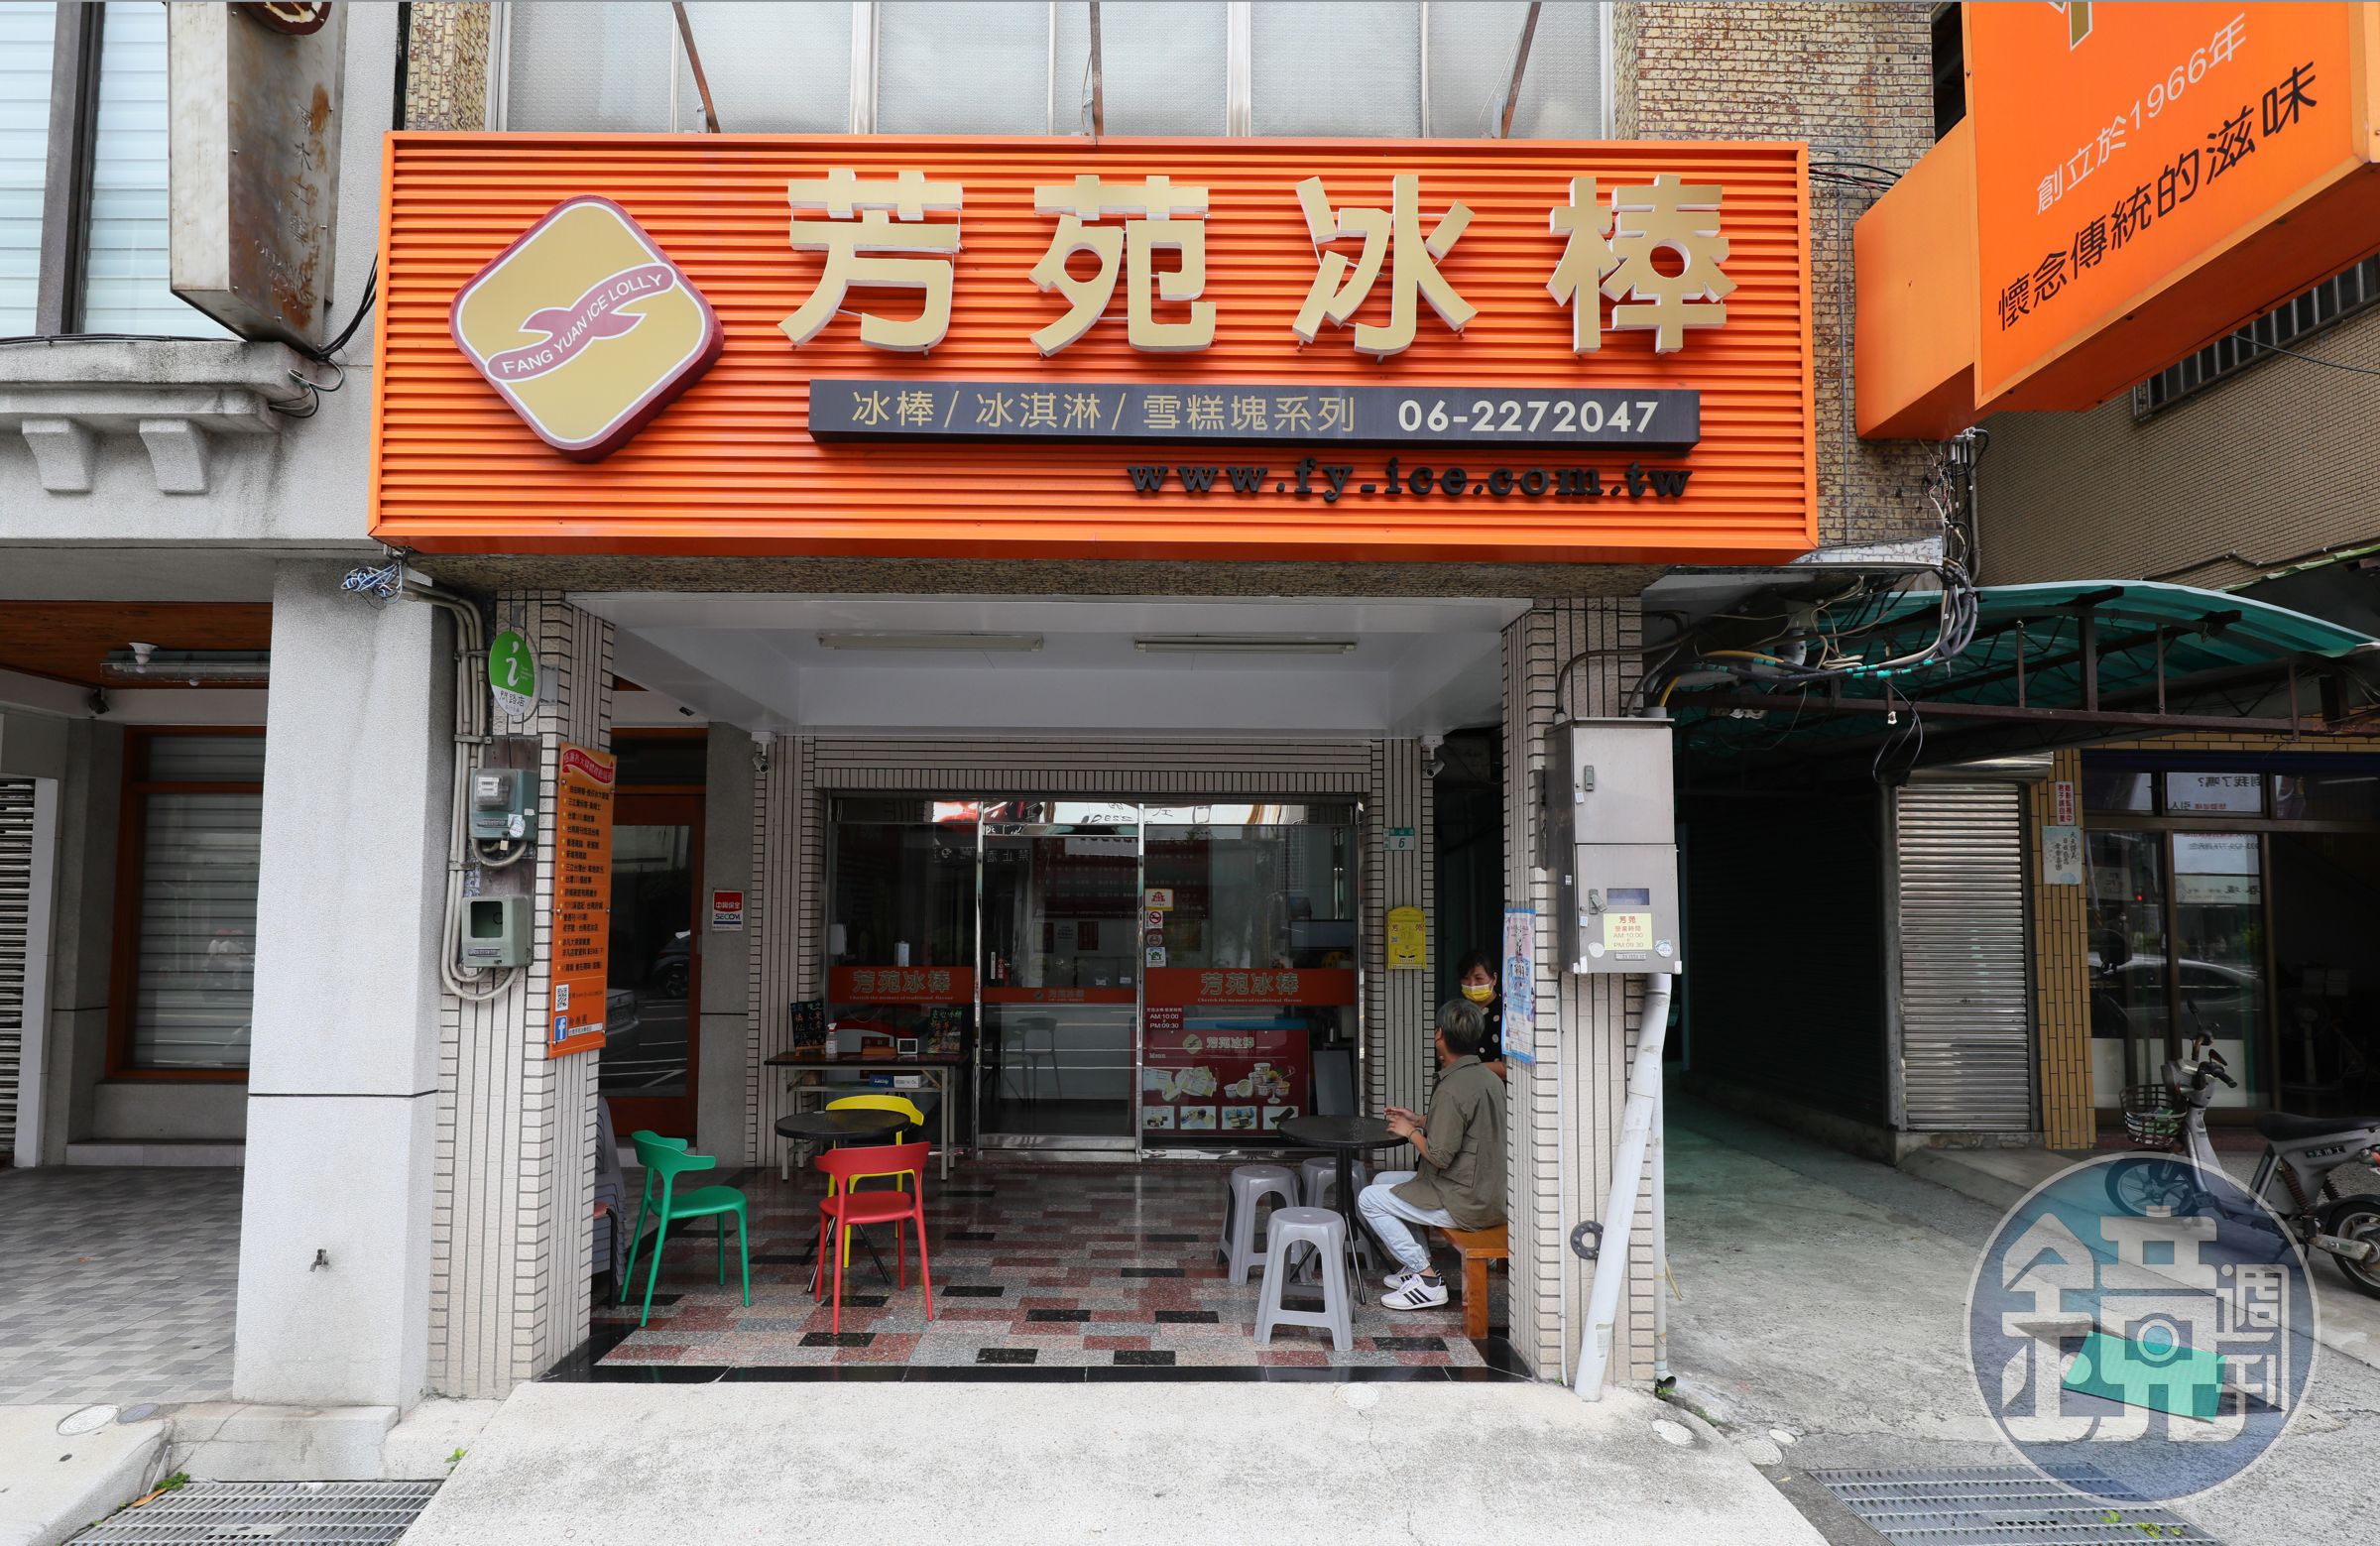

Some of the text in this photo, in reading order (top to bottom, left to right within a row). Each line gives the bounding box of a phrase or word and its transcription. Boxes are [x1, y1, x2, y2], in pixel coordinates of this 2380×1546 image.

[2036, 13, 2247, 215] 創立於1966年
[1998, 60, 2318, 331] 懷念傳統的滋味
[777, 167, 1738, 356] 芳苑冰棒
[501, 273, 662, 374] FANG YUAN ICE LOLLY
[1398, 400, 1659, 434] 06-2272047
[1127, 456, 1694, 504] www.fy-ice.com.tw
[500, 690, 526, 707] 問路店
[1398, 837, 1405, 849] 6
[852, 971, 952, 994] 芳苑冰棒
[1200, 973, 1300, 996] 芳苑冰棒
